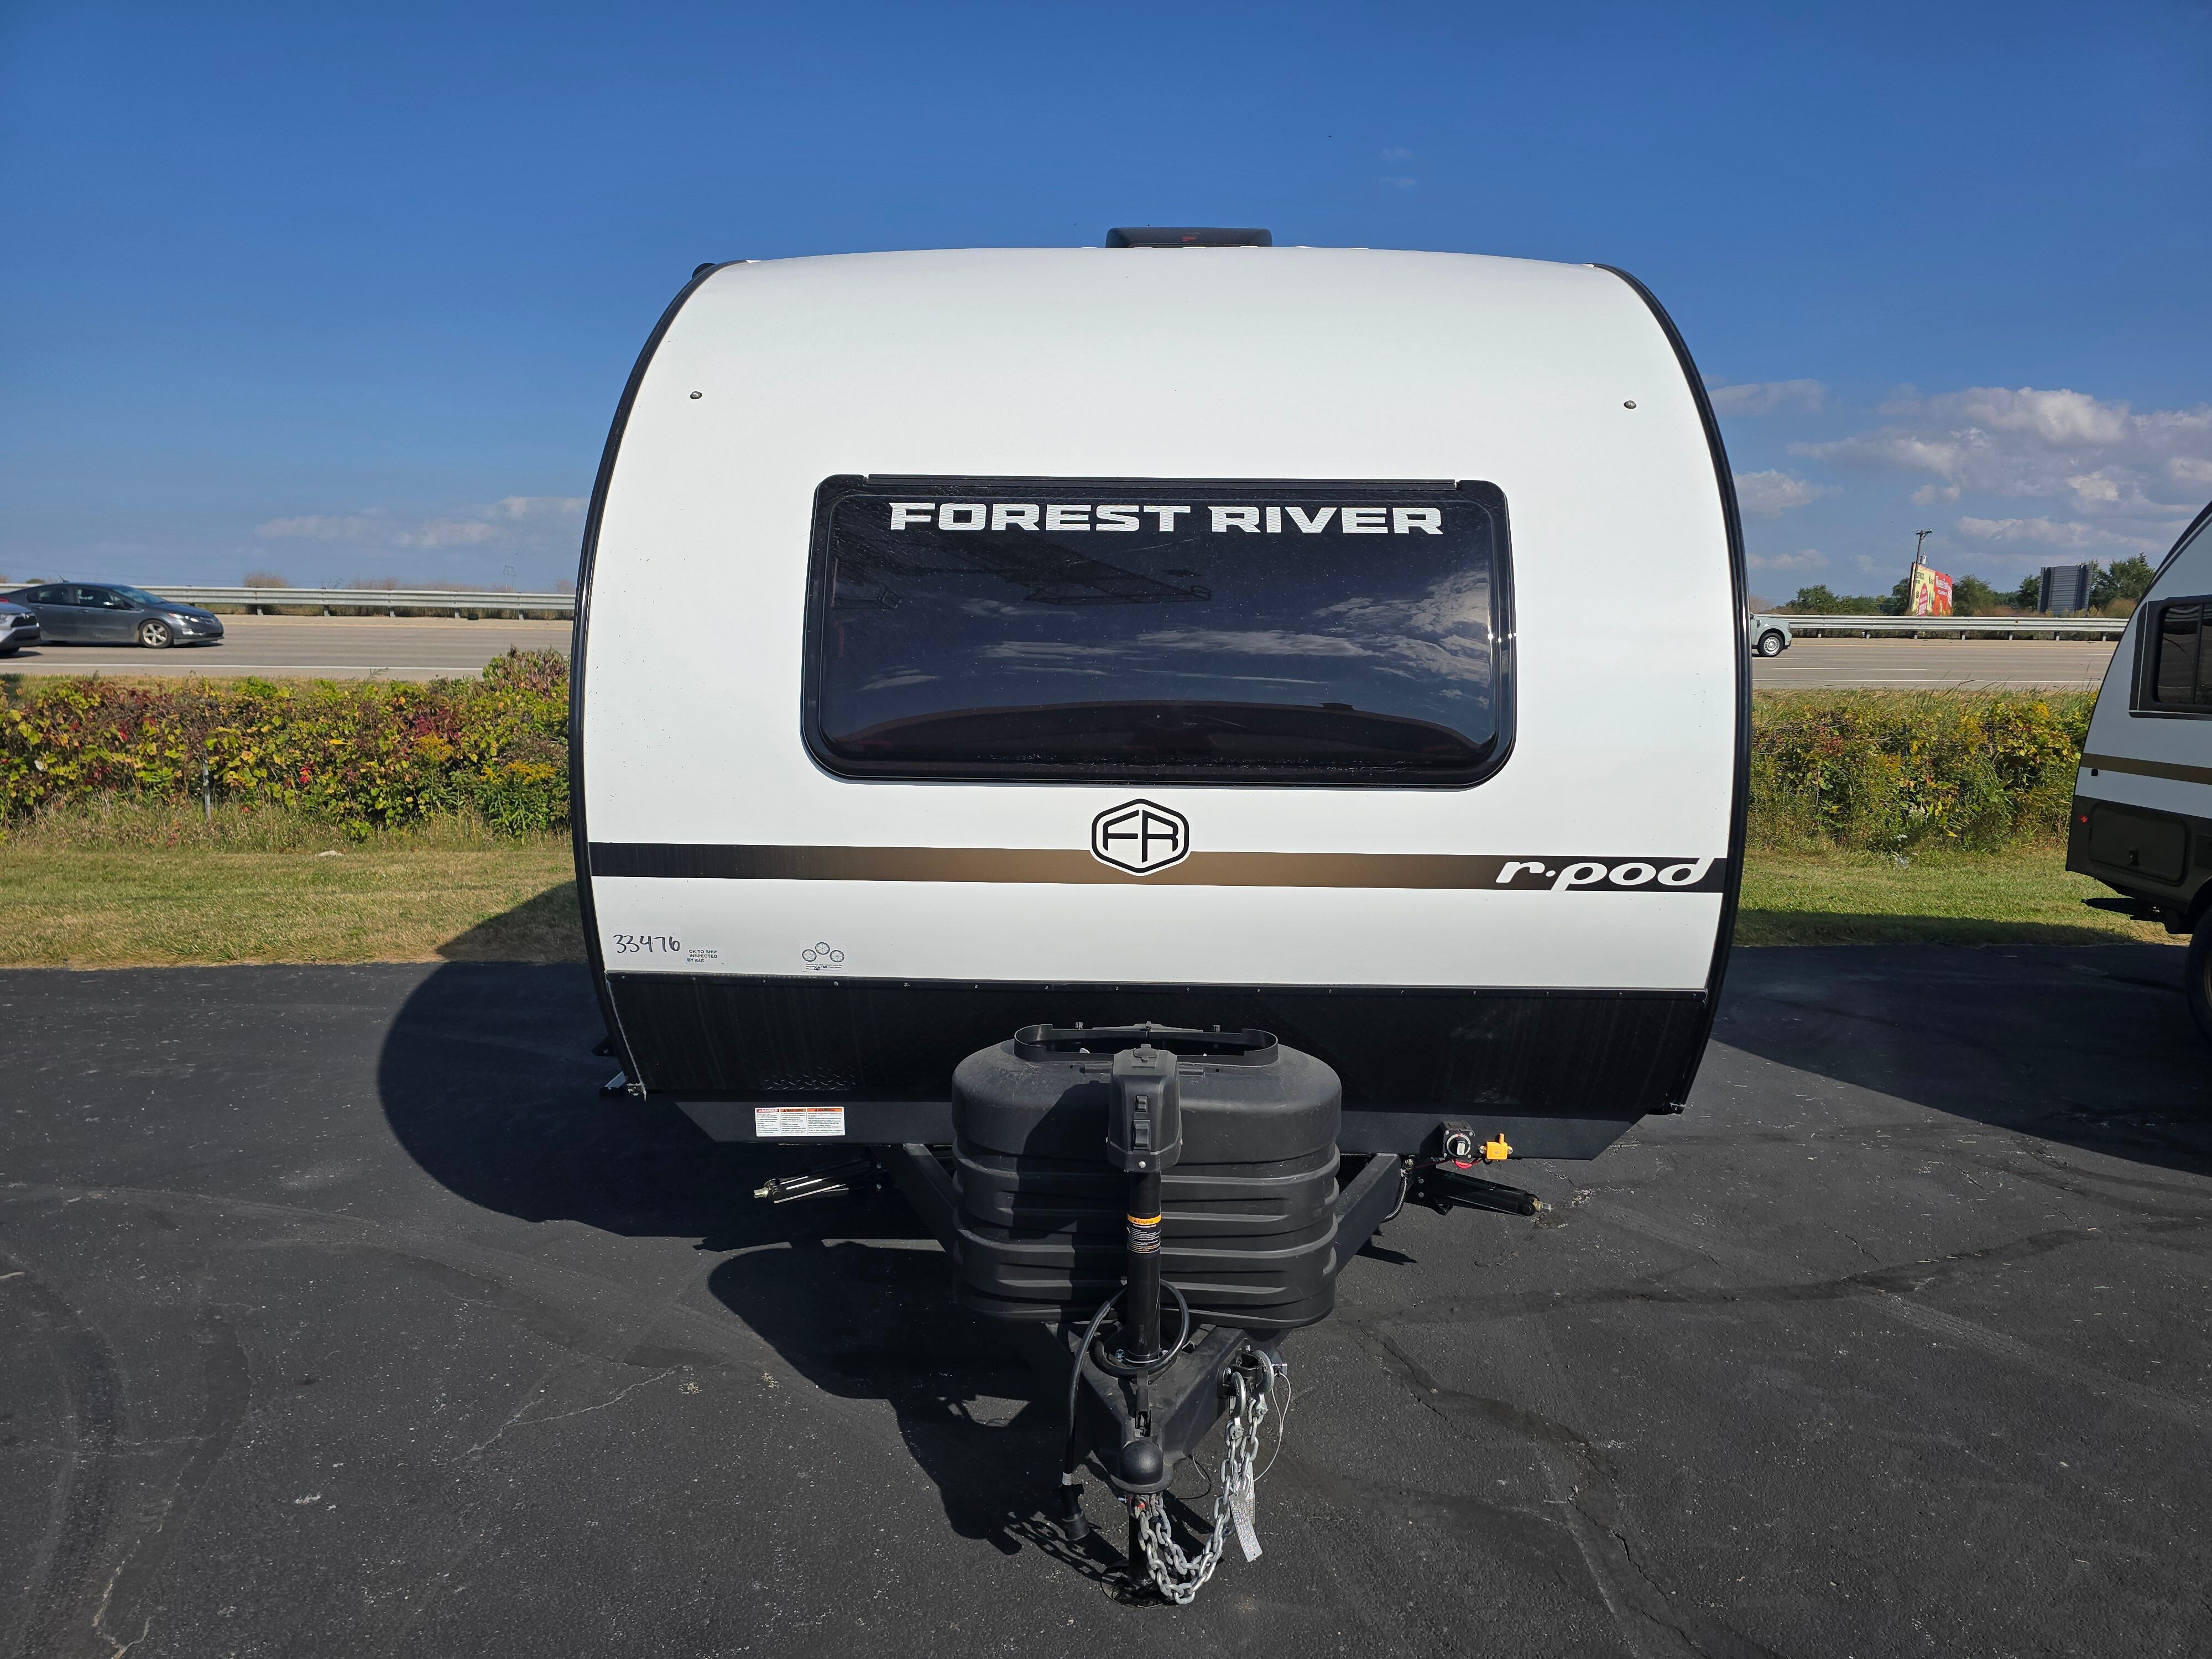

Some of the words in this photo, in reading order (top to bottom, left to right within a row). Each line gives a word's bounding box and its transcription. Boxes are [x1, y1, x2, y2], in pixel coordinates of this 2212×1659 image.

[889, 503, 1191, 531] FOREST
[1208, 507, 1444, 535] RIVER
[613, 935, 680, 953] 33476
